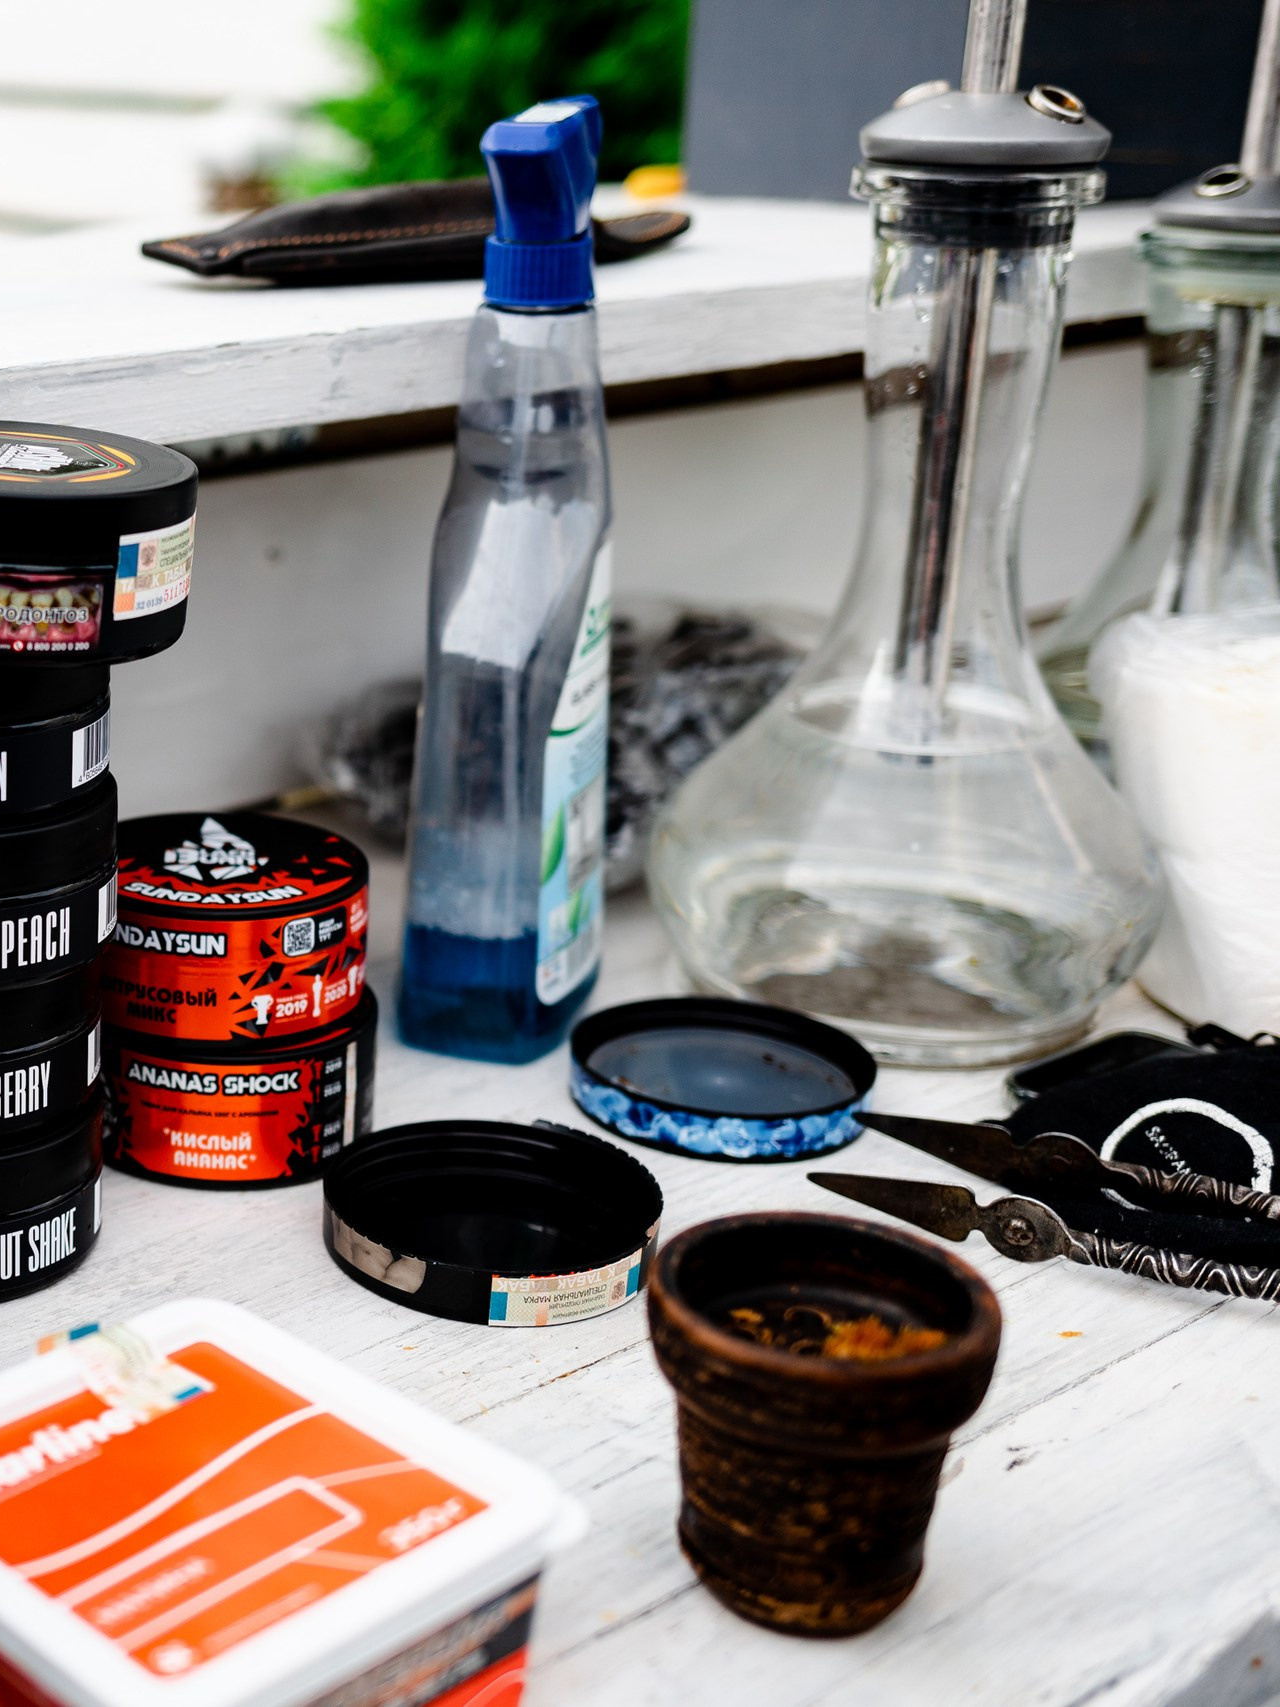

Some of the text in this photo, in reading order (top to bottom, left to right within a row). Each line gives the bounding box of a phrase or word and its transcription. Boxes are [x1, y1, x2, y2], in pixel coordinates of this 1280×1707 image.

[123, 881, 304, 905] SUNDAYSUN
[1, 906, 70, 969] PEACH
[114, 923, 225, 956] NDAYSUN
[127, 1001, 176, 1023] МИКС
[275, 998, 308, 1018] 2019
[129, 1063, 218, 1093] ANANAS
[224, 1071, 299, 1094] SHOCK
[28, 1206, 77, 1273] SHAKE
[523, 1283, 607, 1304] СПЕЦИАЛЬНАЯ МАРКА
